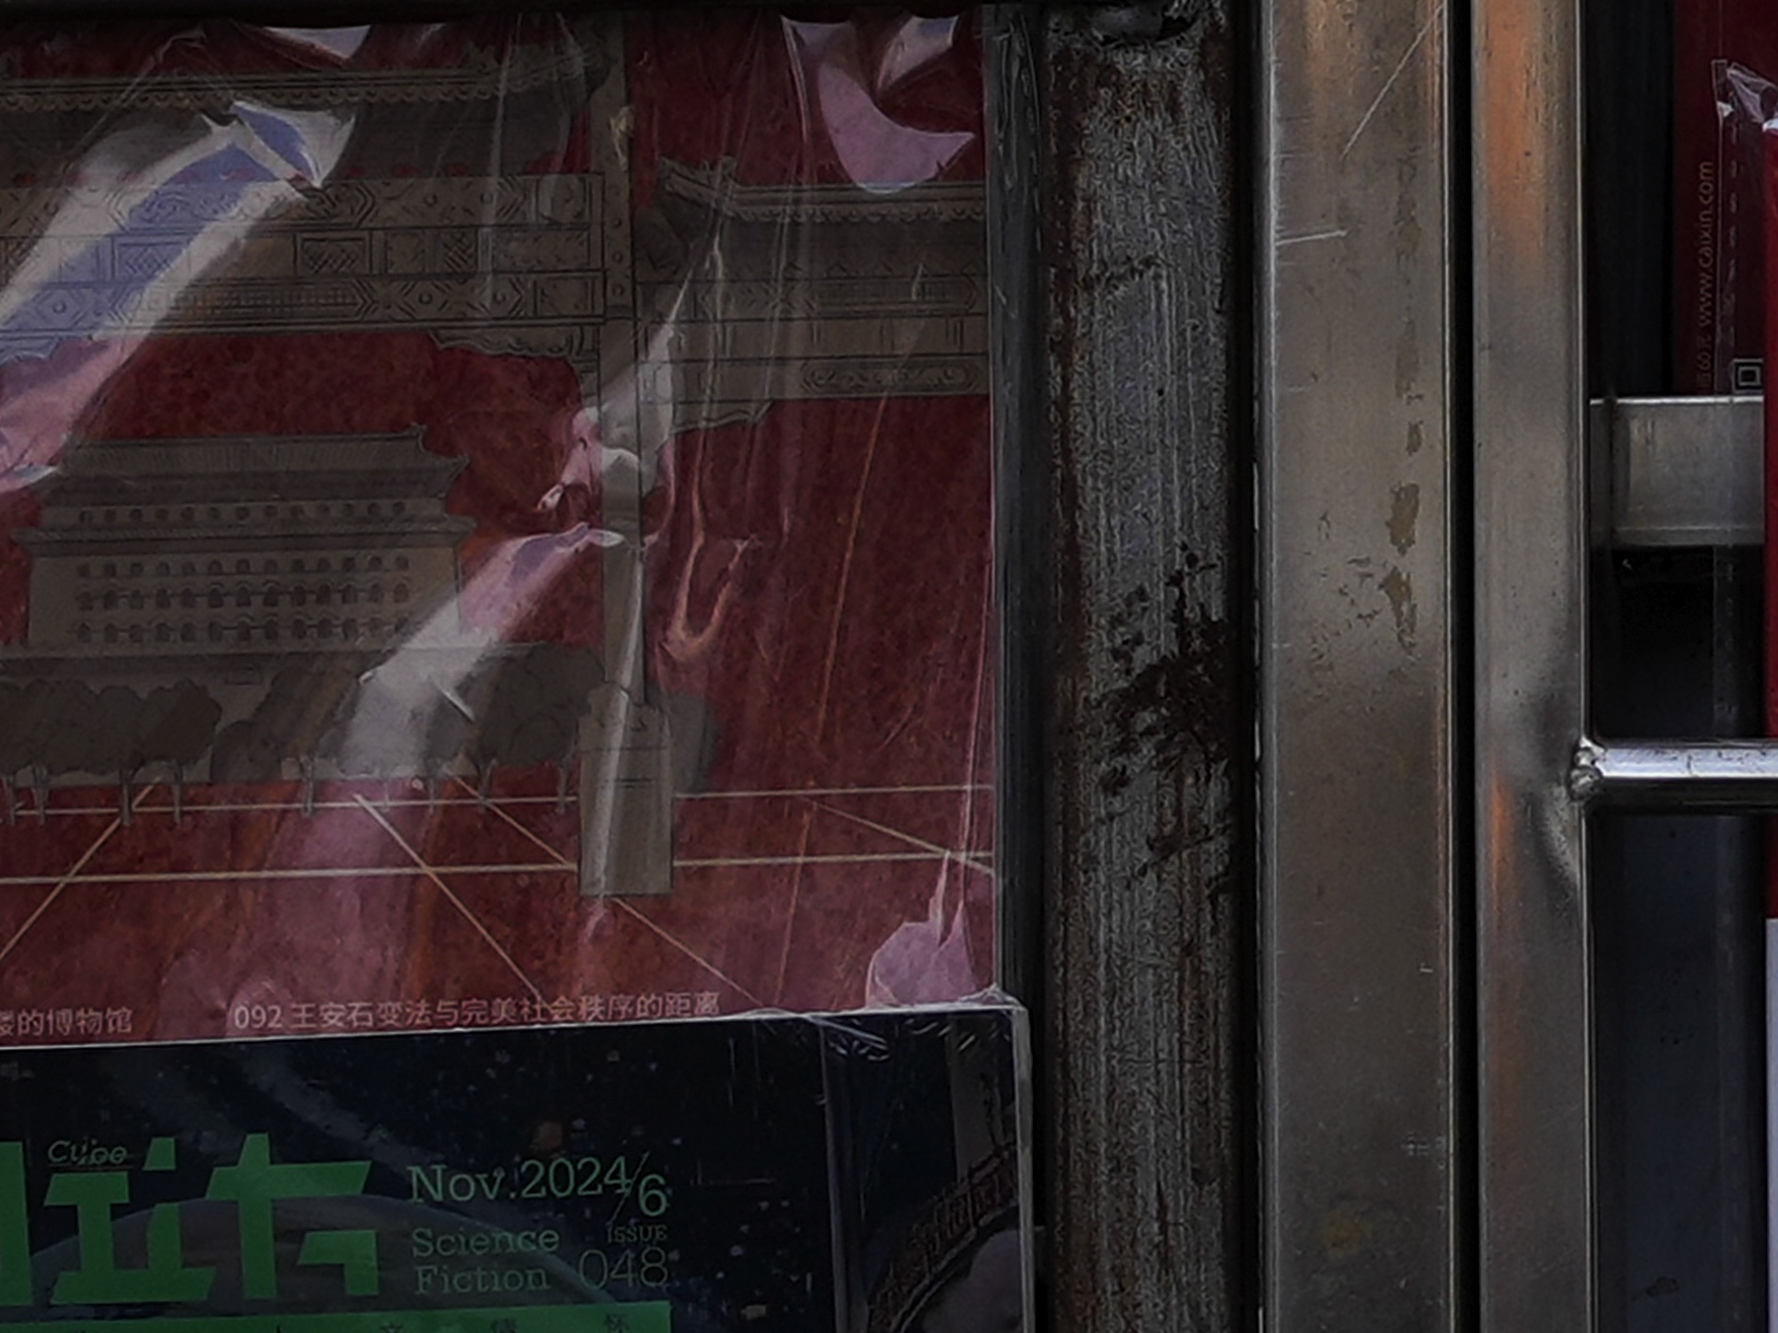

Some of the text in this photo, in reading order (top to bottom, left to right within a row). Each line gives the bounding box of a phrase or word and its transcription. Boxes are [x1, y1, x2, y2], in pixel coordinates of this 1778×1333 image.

[234, 1006, 282, 1029] 092
[412, 1227, 561, 1258] Science
[413, 1247, 669, 1295] Fiction 048
